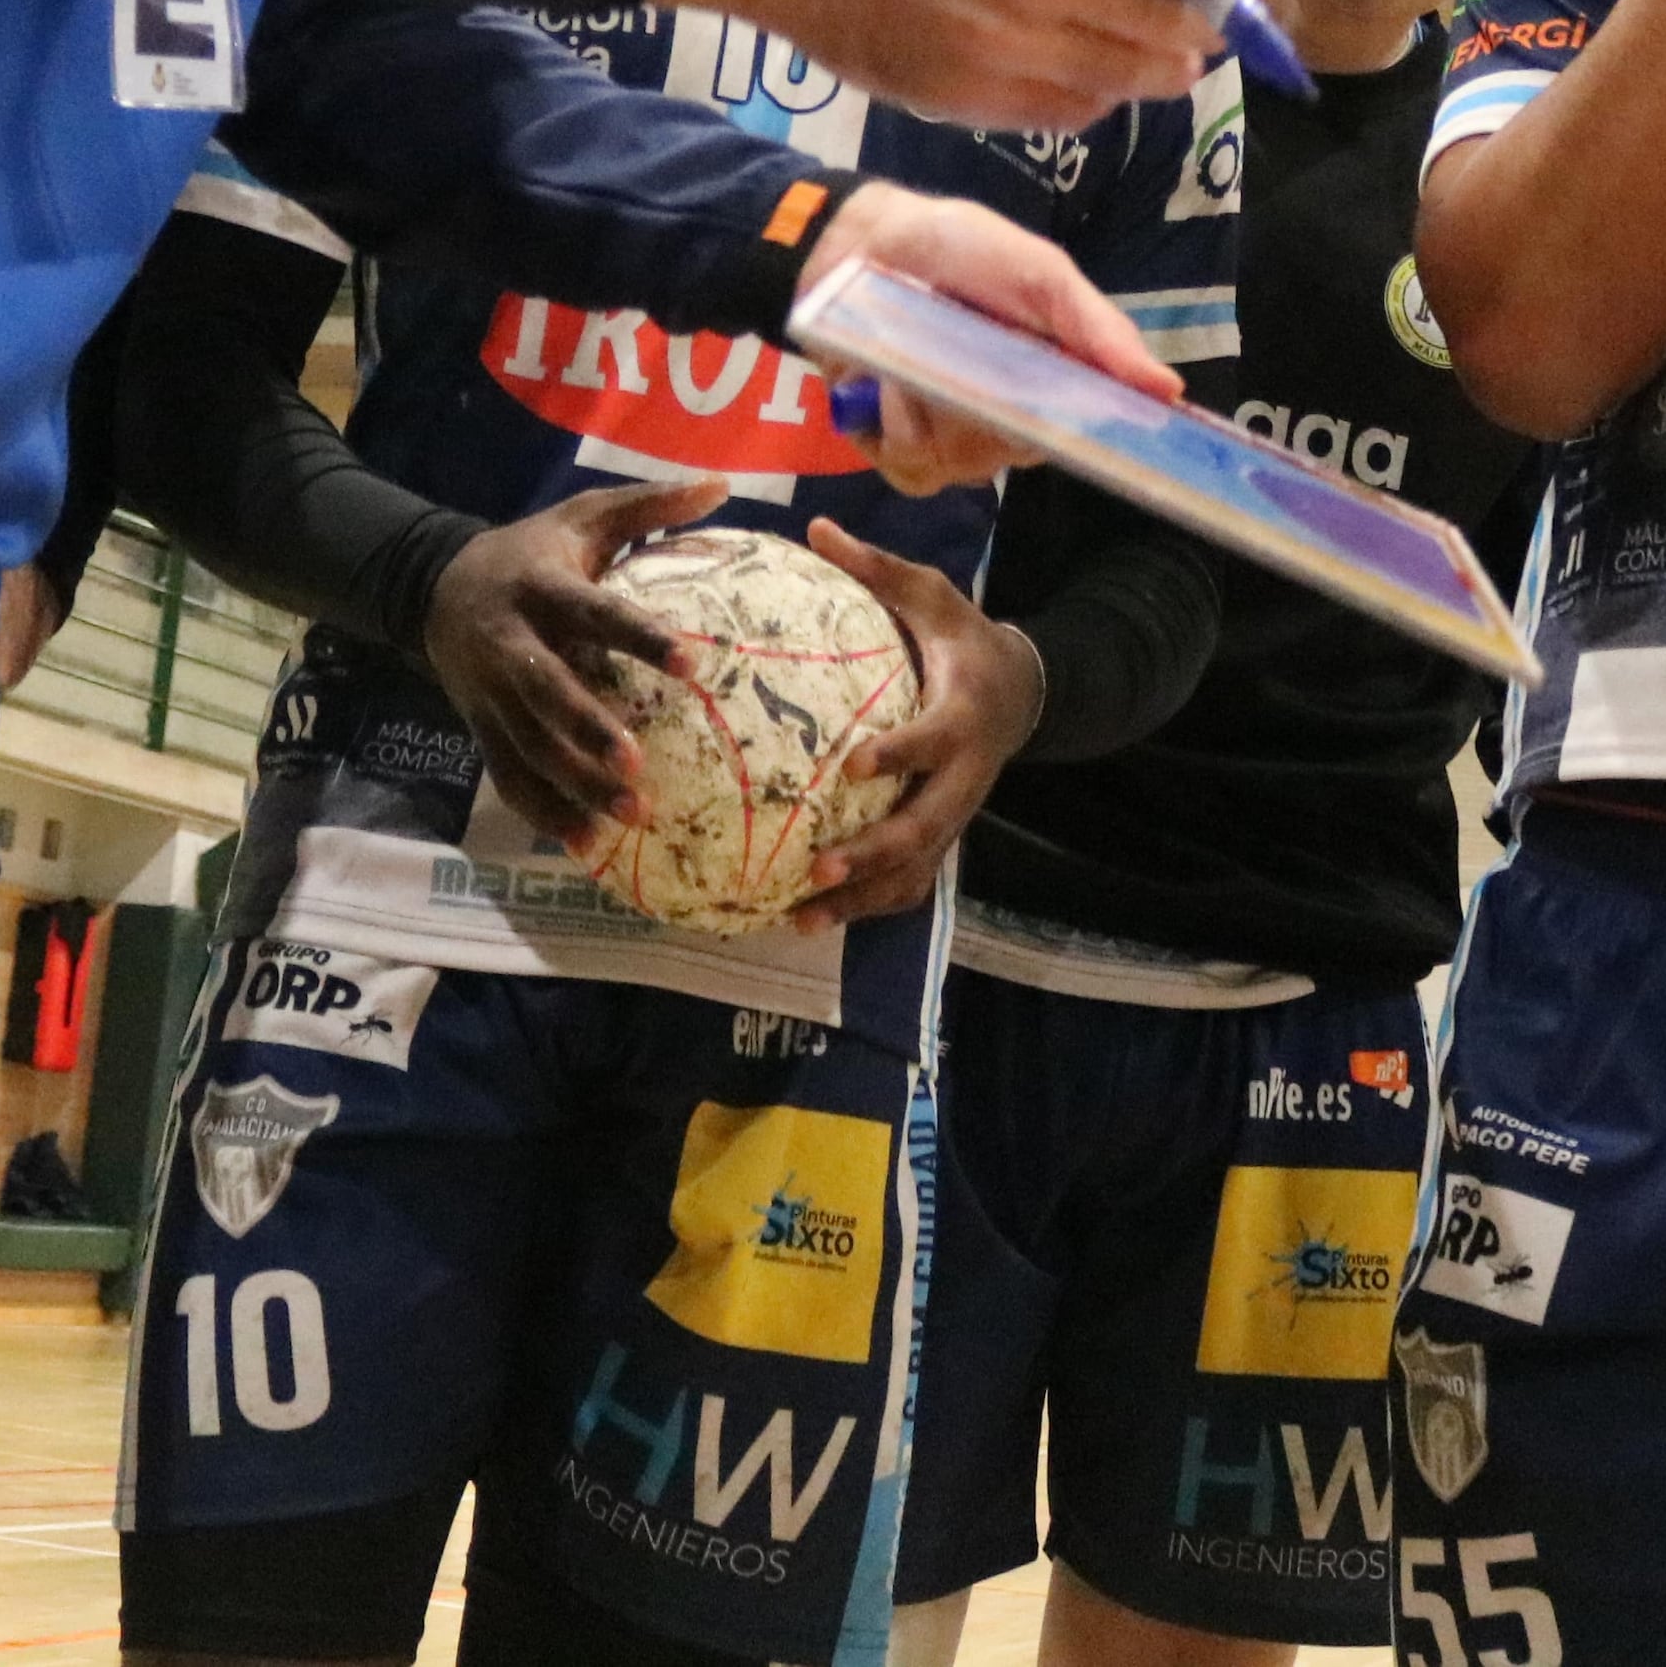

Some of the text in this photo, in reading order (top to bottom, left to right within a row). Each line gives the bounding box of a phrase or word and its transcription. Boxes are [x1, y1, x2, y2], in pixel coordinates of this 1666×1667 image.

[258, 941, 331, 966] GRUPO
[1247, 1066, 1353, 1122] nPie.es
[203, 1116, 297, 1141] MALACITAN
[1471, 1105, 1579, 1149] AUTOBUSES
[1518, 1139, 1591, 1175] PEPE
[791, 1202, 858, 1229] Pinturas
[1436, 1209, 1501, 1267] RP
[1298, 1247, 1391, 1291] Sixto
[1331, 1251, 1390, 1267] Pinturas
[175, 1269, 332, 1437] 10
[573, 1343, 856, 1542] HW
[1175, 1416, 1393, 1543] HW
[553, 1454, 793, 1586] INGENIEROS
[1168, 1530, 1387, 1581] INGENIEROS
[1398, 1534, 1563, 1667] 55
